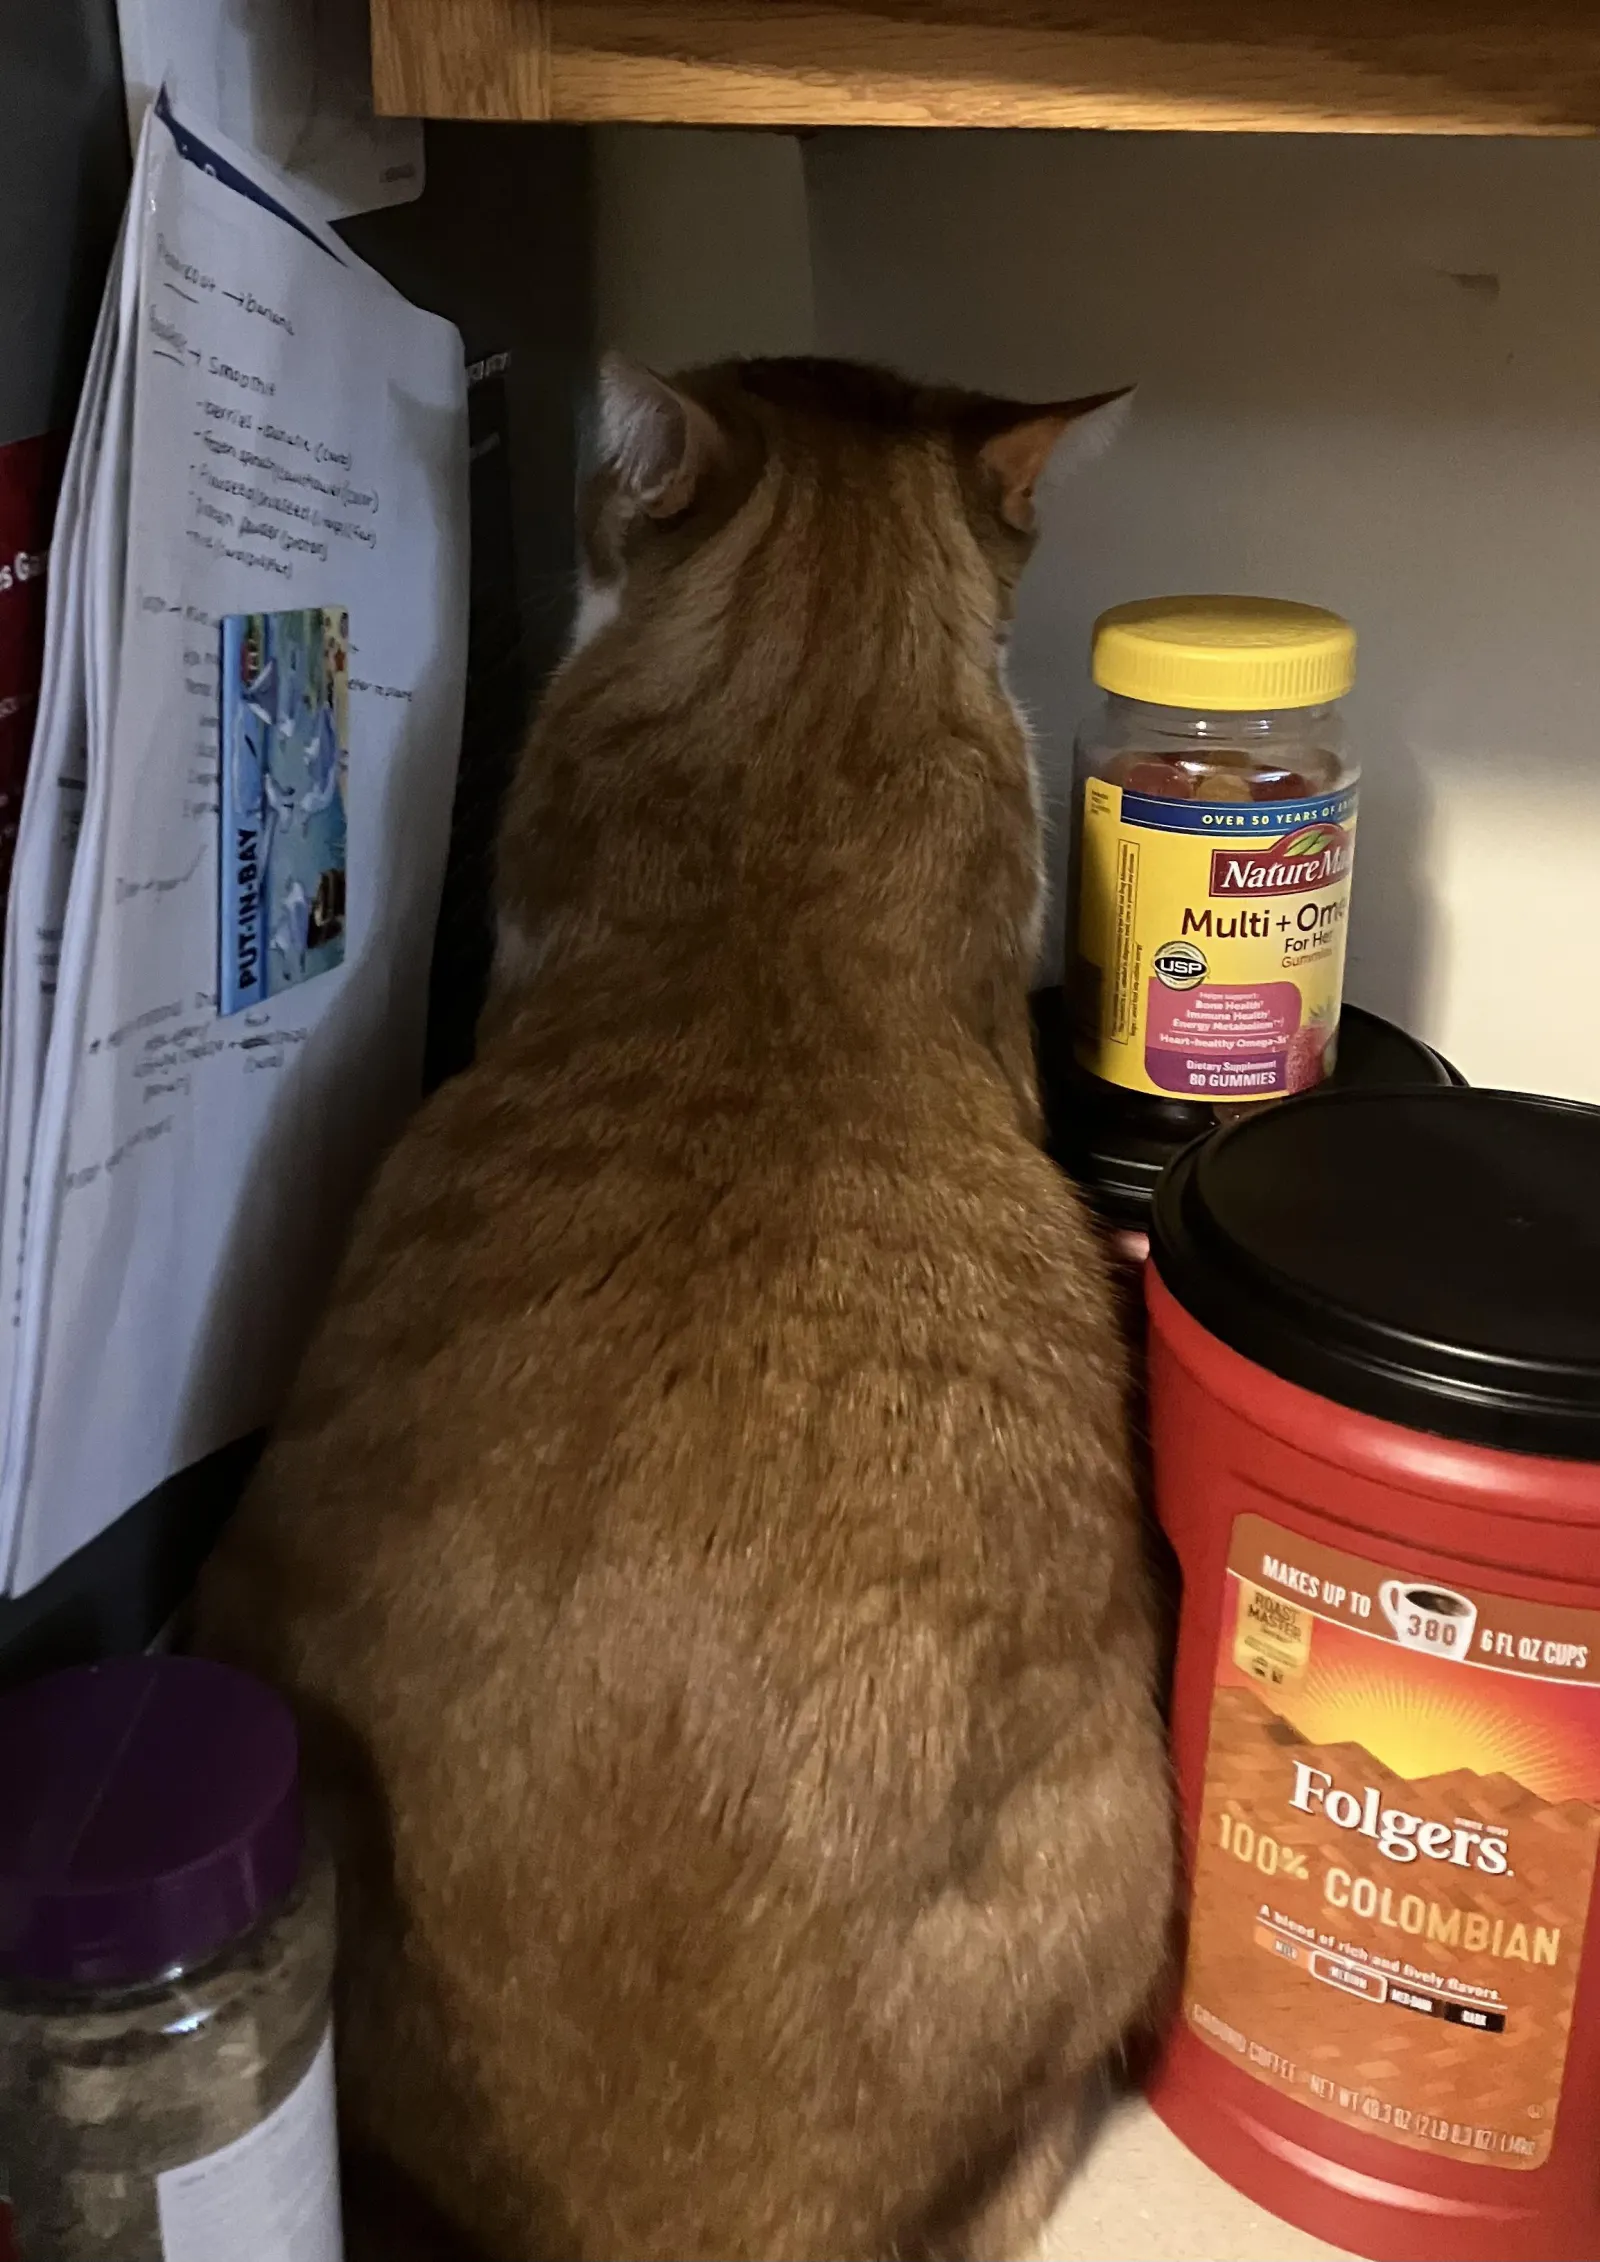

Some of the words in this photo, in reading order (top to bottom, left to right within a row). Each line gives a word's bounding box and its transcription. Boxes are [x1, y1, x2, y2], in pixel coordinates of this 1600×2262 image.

[1202, 814, 1245, 826] OVER
[1251, 815, 1270, 825] 50
[1276, 809, 1318, 824] YEARS
[1322, 807, 1336, 817] OF
[1220, 860, 1319, 888] Nature
[238, 828, 259, 989] PUT-IN-BAY
[1181, 907, 1270, 938] Multi
[1276, 915, 1291, 932] +
[1284, 936, 1309, 953] For
[1313, 930, 1333, 948] Her
[1160, 959, 1203, 975] USP
[1195, 1000, 1224, 1010] Bone
[1172, 1018, 1211, 1032] Energy
[1159, 1033, 1235, 1050] Heart-healthy
[1186, 1060, 1222, 1073] Dietary
[1223, 1060, 1277, 1073] Supplement
[1189, 1073, 1206, 1086] 80
[1208, 1072, 1277, 1087] GUMMIES
[1262, 1554, 1320, 1598] MAKES
[1322, 1580, 1346, 1607] UP
[1350, 1592, 1372, 1618] TO
[1248, 1604, 1302, 1640] MASTER
[1255, 1591, 1300, 1624] ROAST
[1407, 1614, 1457, 1646] 380
[1480, 1629, 1494, 1650] 6
[1496, 1634, 1516, 1658] FL
[1519, 1640, 1541, 1663] OZ
[1543, 1642, 1588, 1670] CUPS
[1219, 1813, 1310, 1880] 100%
[1324, 1866, 1561, 1967] COLOMBIAN
[1259, 1904, 1270, 1917] A
[1273, 1911, 1316, 1940] blend
[1319, 1934, 1336, 1947] of
[1338, 1942, 1369, 1962] rich
[1371, 1956, 1400, 1973] and
[1403, 1963, 1445, 1989] lively
[1310, 2073, 1335, 2100] NET
[1339, 2086, 1359, 2112] WT
[1431, 2119, 1449, 2141] LB
